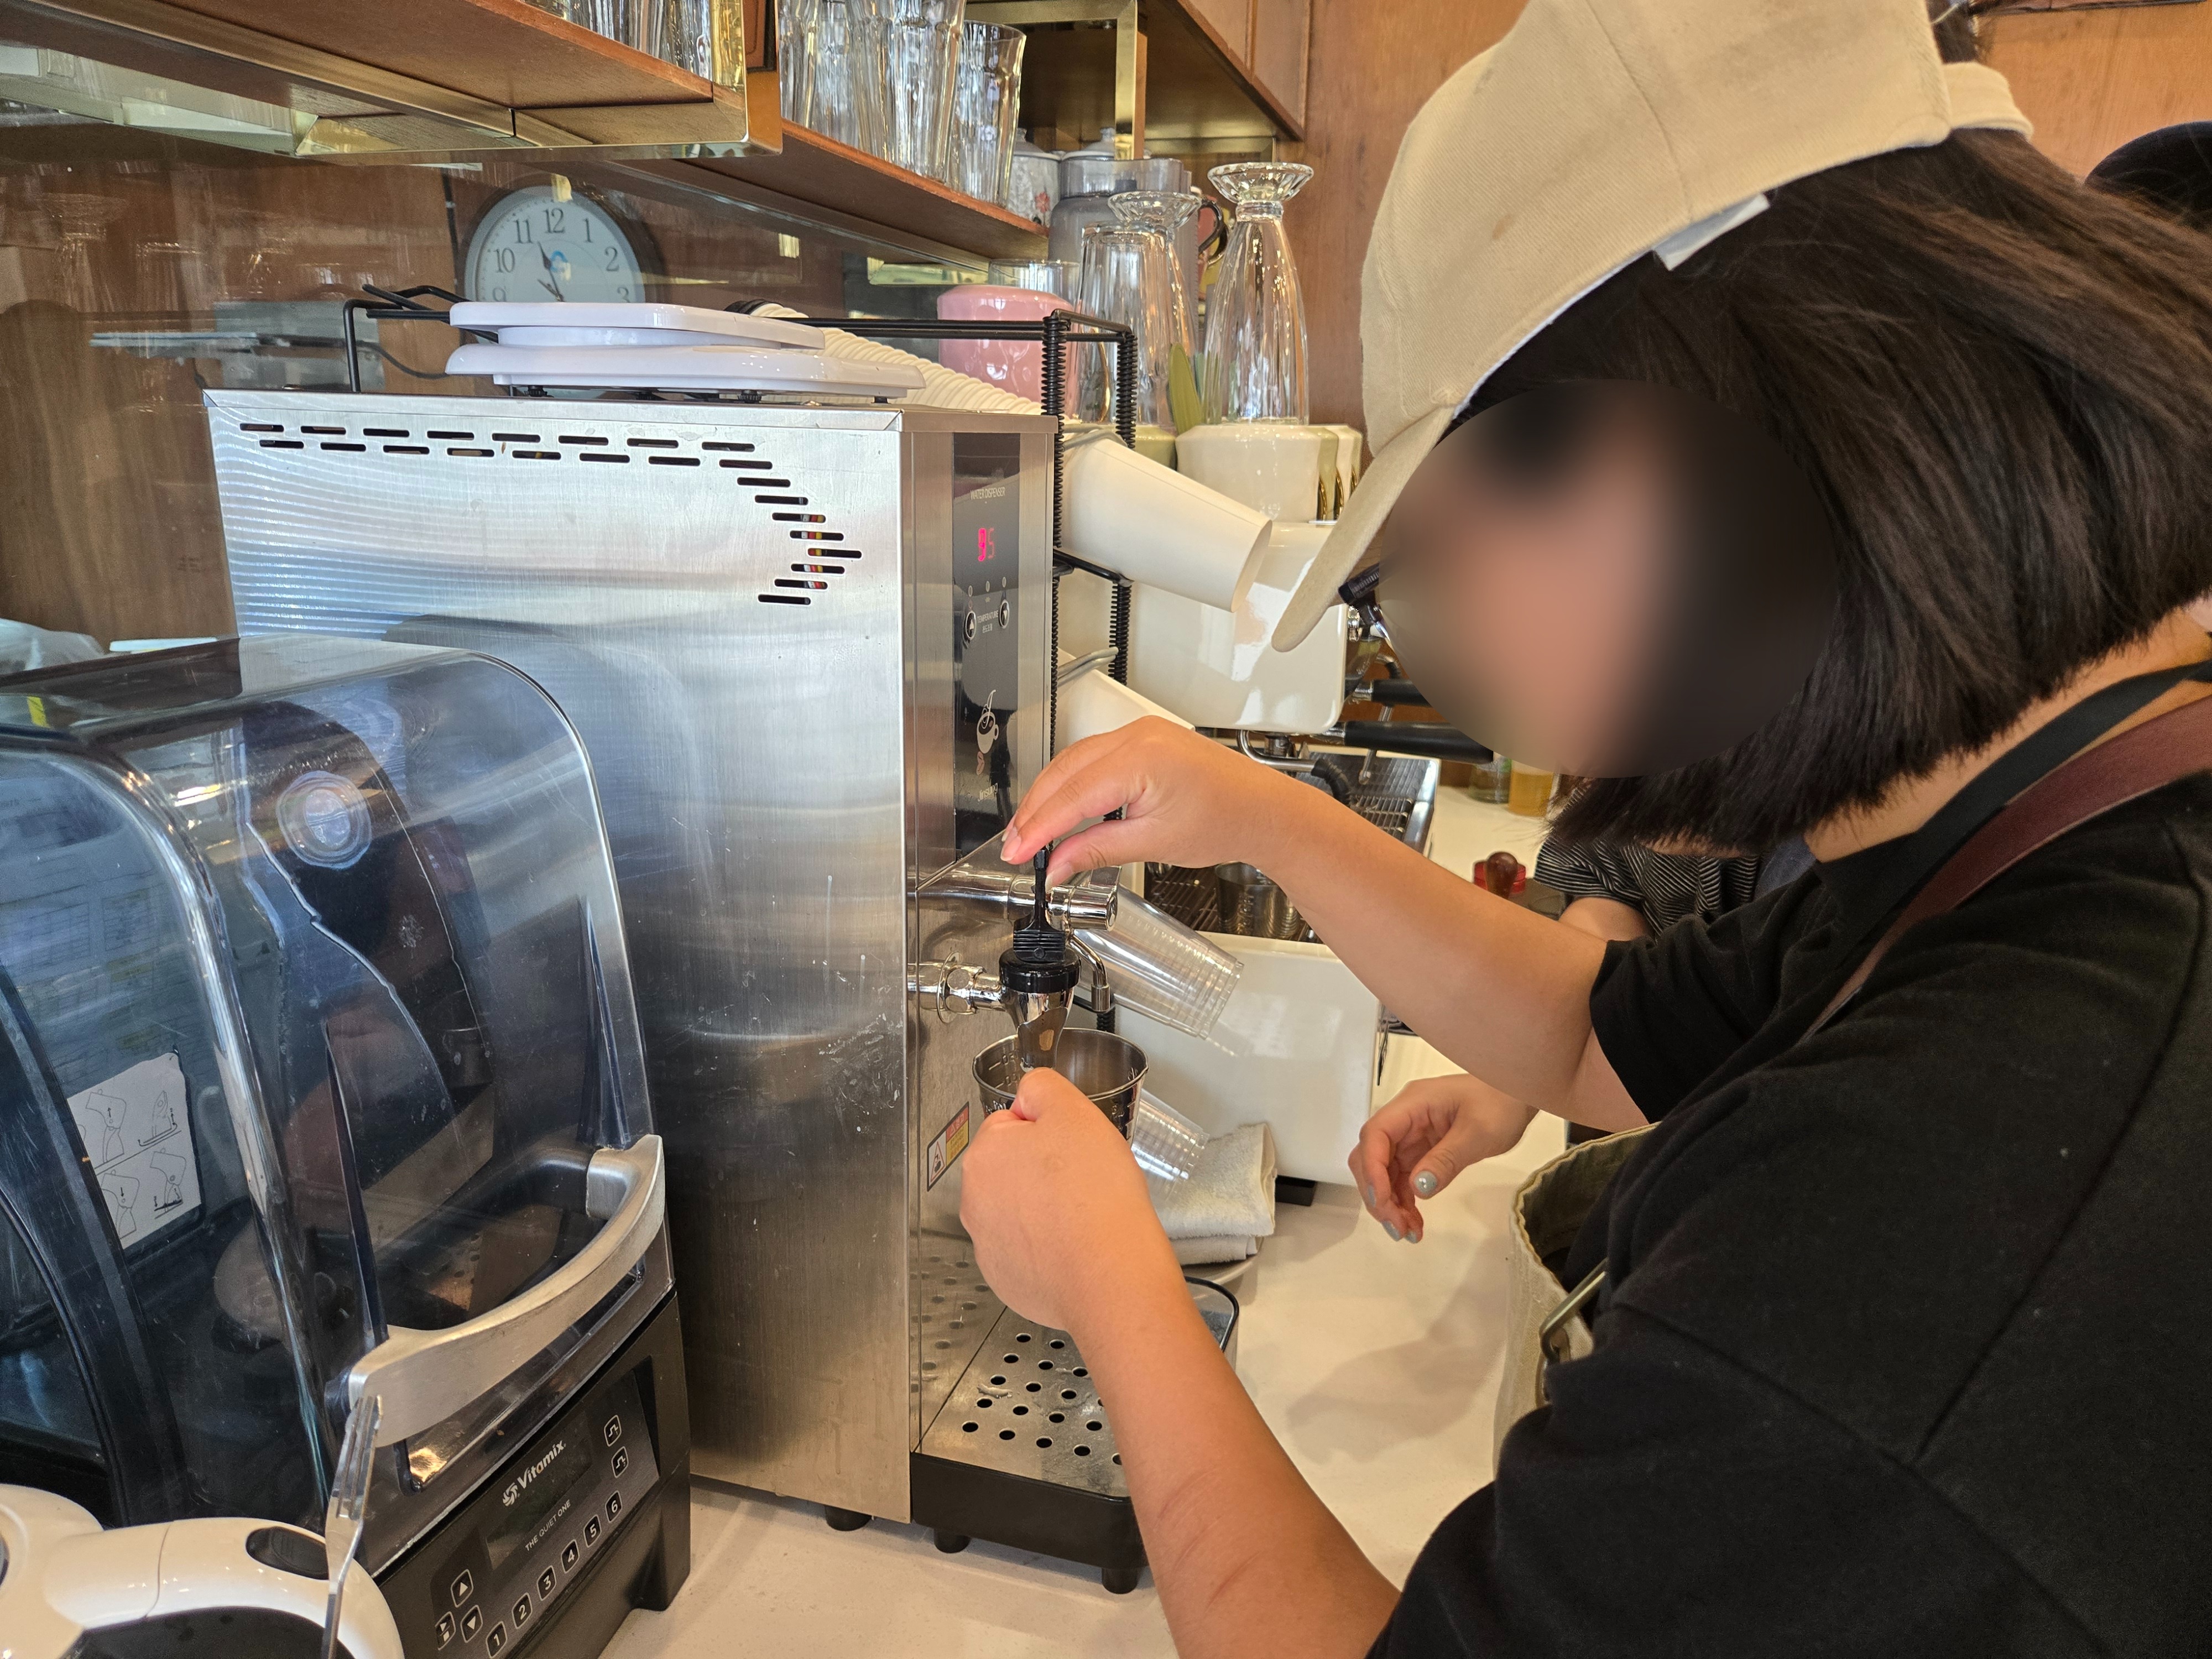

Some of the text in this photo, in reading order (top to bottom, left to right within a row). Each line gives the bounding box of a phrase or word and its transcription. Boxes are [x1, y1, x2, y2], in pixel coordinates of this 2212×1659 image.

[544, 207, 565, 233] 12
[514, 218, 533, 244] 11
[583, 218, 593, 243] 1
[493, 247, 515, 273] 10
[604, 246, 620, 272] 2
[970, 487, 1006, 500] WATER DISPENSER
[978, 527, 995, 562] 95
[977, 609, 999, 624] TEMPERATURE
[977, 782, 998, 802] Jinsung
[517, 1439, 566, 1489] Vitamix
[611, 1500, 618, 1513] 6
[525, 1499, 571, 1552] THE QUIET ONE
[589, 1524, 597, 1538] 5
[567, 1549, 576, 1563] 4
[543, 1575, 551, 1590] 3
[518, 1604, 526, 1620] 2
[493, 1634, 500, 1646] 1
